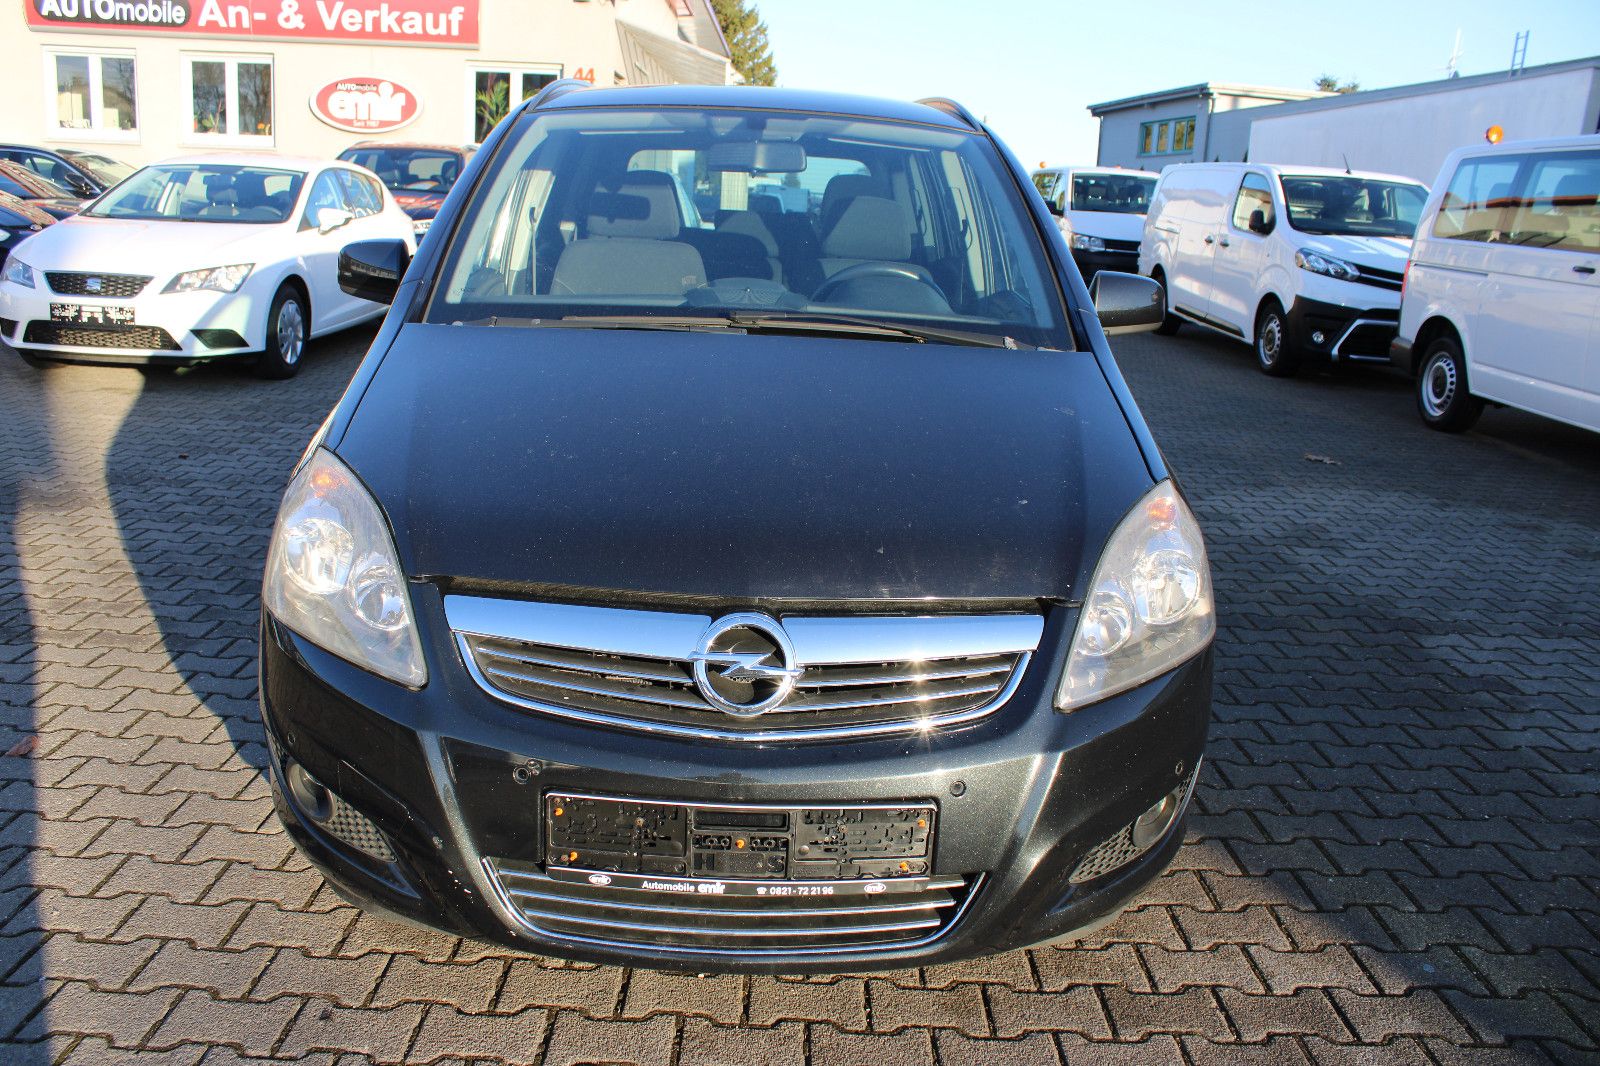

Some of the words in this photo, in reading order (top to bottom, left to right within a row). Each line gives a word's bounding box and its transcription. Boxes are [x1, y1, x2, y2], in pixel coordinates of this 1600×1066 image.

[277, 0, 306, 30] &
[316, 0, 465, 36] Verkauf
[573, 67, 596, 84] 44
[328, 81, 406, 121] emir
[642, 880, 695, 892] Automobile
[697, 881, 726, 894] emir
